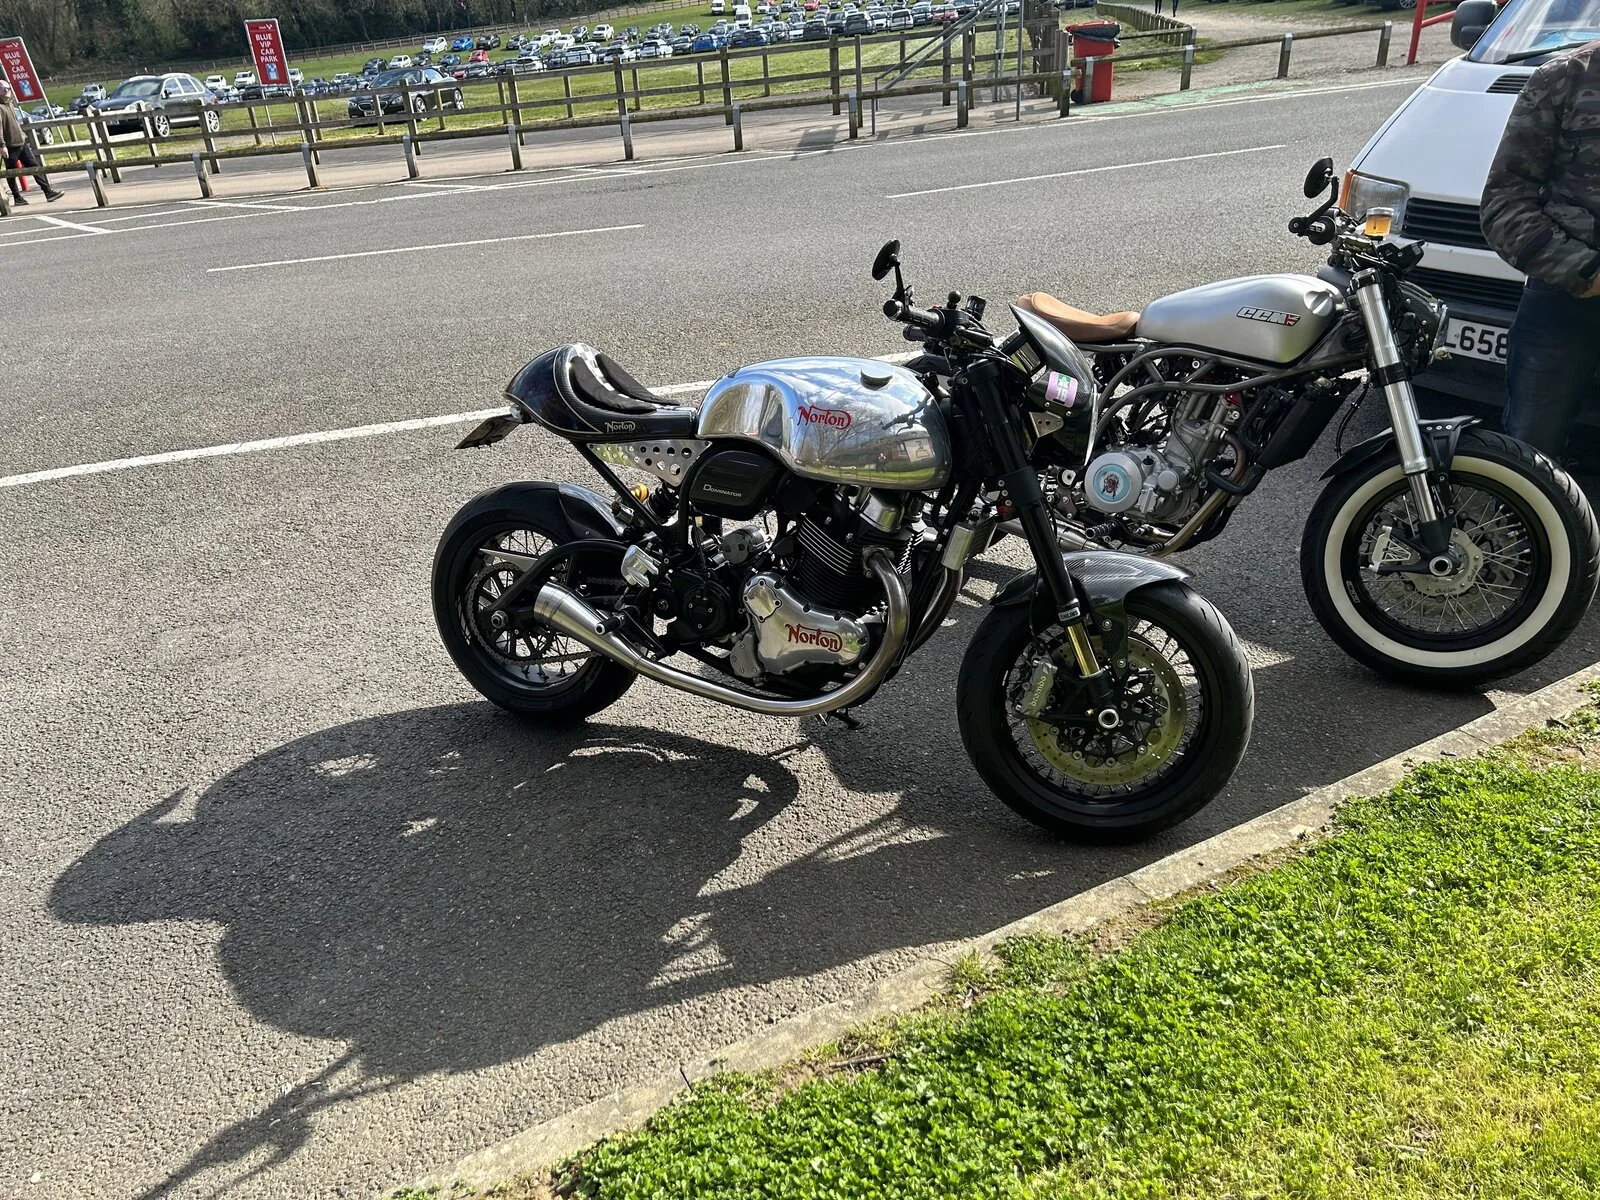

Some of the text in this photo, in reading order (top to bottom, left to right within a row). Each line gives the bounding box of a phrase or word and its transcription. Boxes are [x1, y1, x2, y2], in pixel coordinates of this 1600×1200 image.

[255, 33, 273, 41] BLUE
[3, 51, 21, 60] BLUE
[260, 48, 275, 56] CAR
[260, 55, 279, 63] PARK
[11, 65, 26, 73] CAR
[12, 72, 30, 80] PARK
[1236, 306, 1287, 325] CCM
[797, 404, 852, 430] Norton
[604, 420, 636, 433] Norton
[784, 623, 843, 653] Norton
[1028, 675, 1047, 707] brembo
